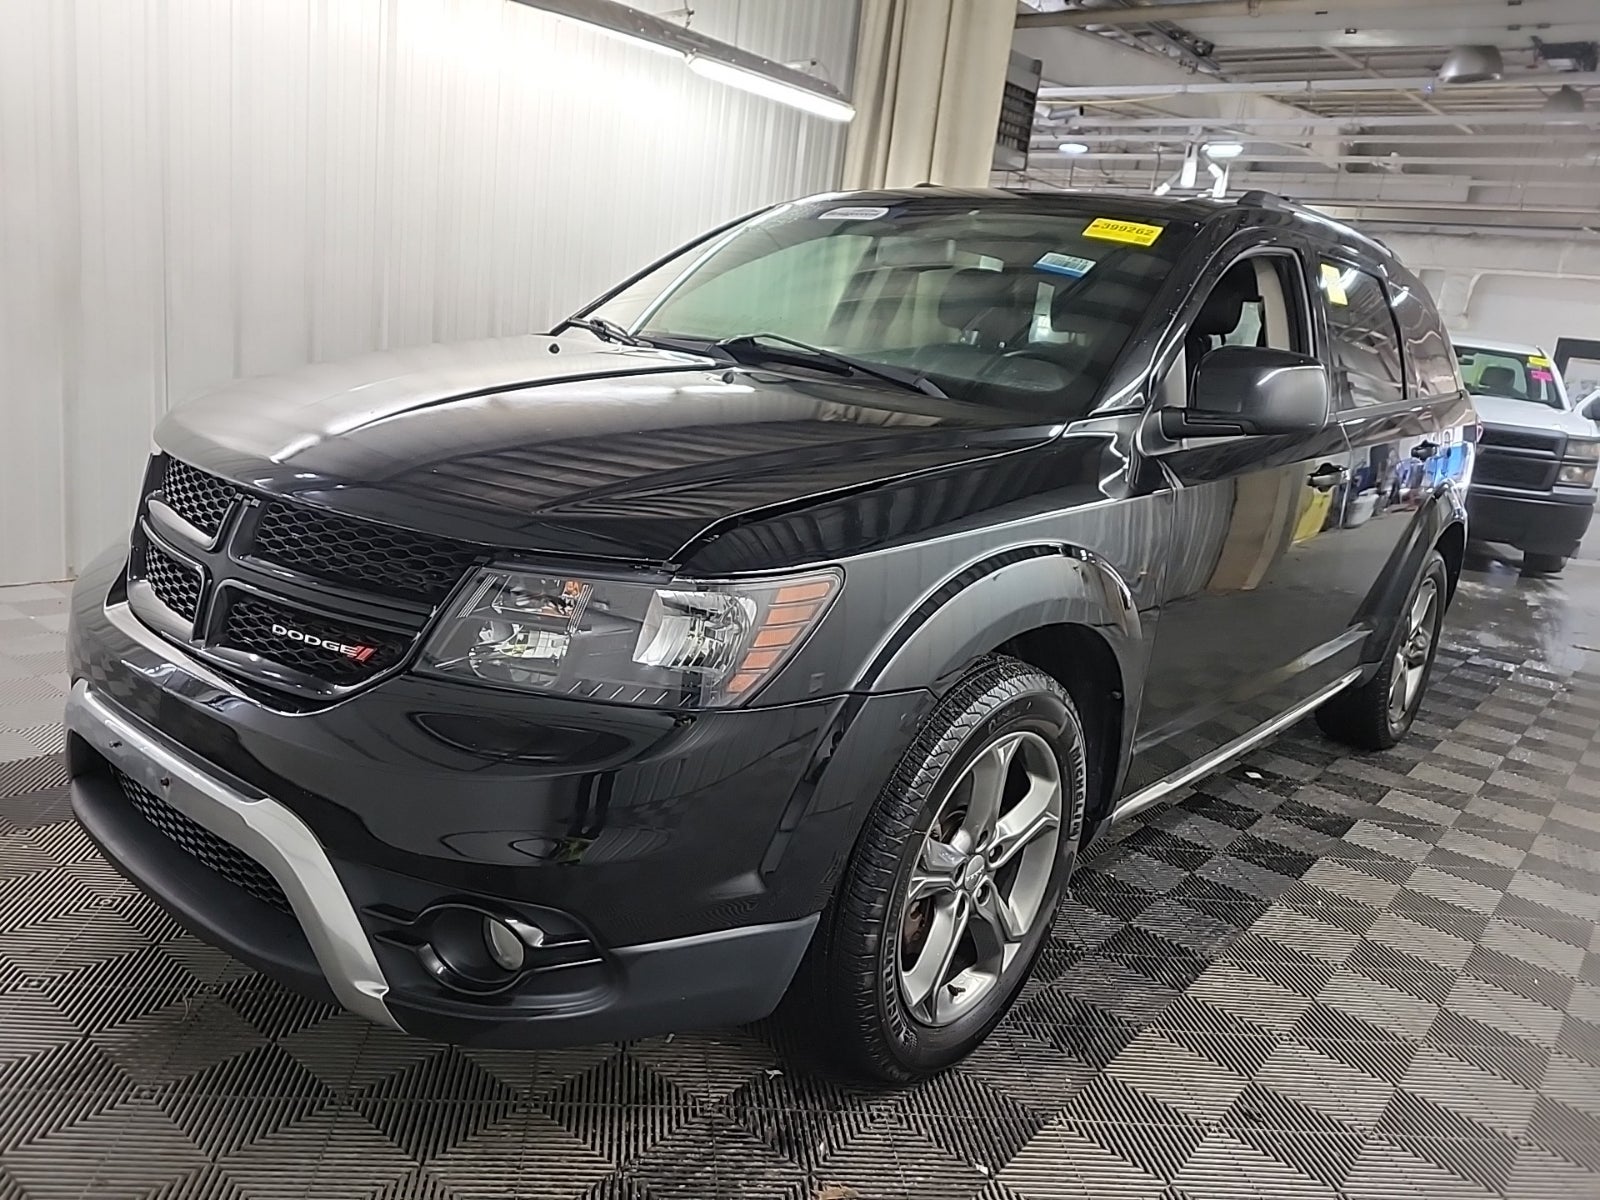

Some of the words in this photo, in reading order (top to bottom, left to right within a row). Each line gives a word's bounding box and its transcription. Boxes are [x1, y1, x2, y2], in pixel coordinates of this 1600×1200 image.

[1101, 222, 1155, 236] 399262
[272, 623, 359, 658] DODGE
[1070, 744, 1086, 834] MICHELIN
[884, 937, 903, 1038] MICHELIN
